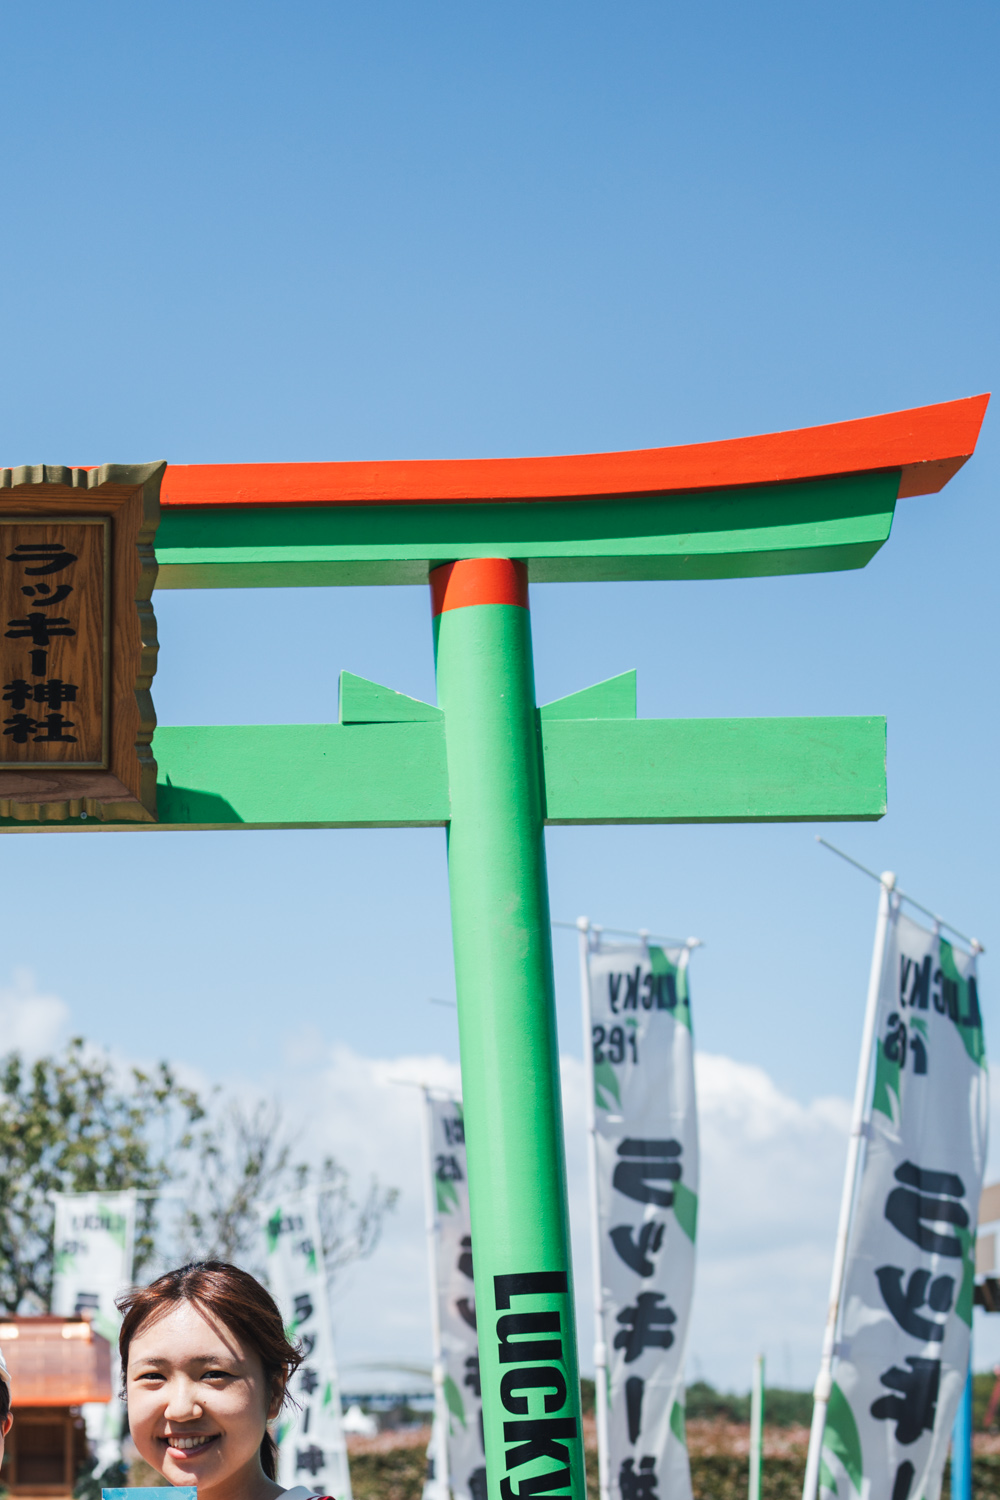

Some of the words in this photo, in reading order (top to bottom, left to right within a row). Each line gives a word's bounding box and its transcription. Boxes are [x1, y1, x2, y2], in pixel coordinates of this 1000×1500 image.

[4, 543, 78, 744] ラッキー神社
